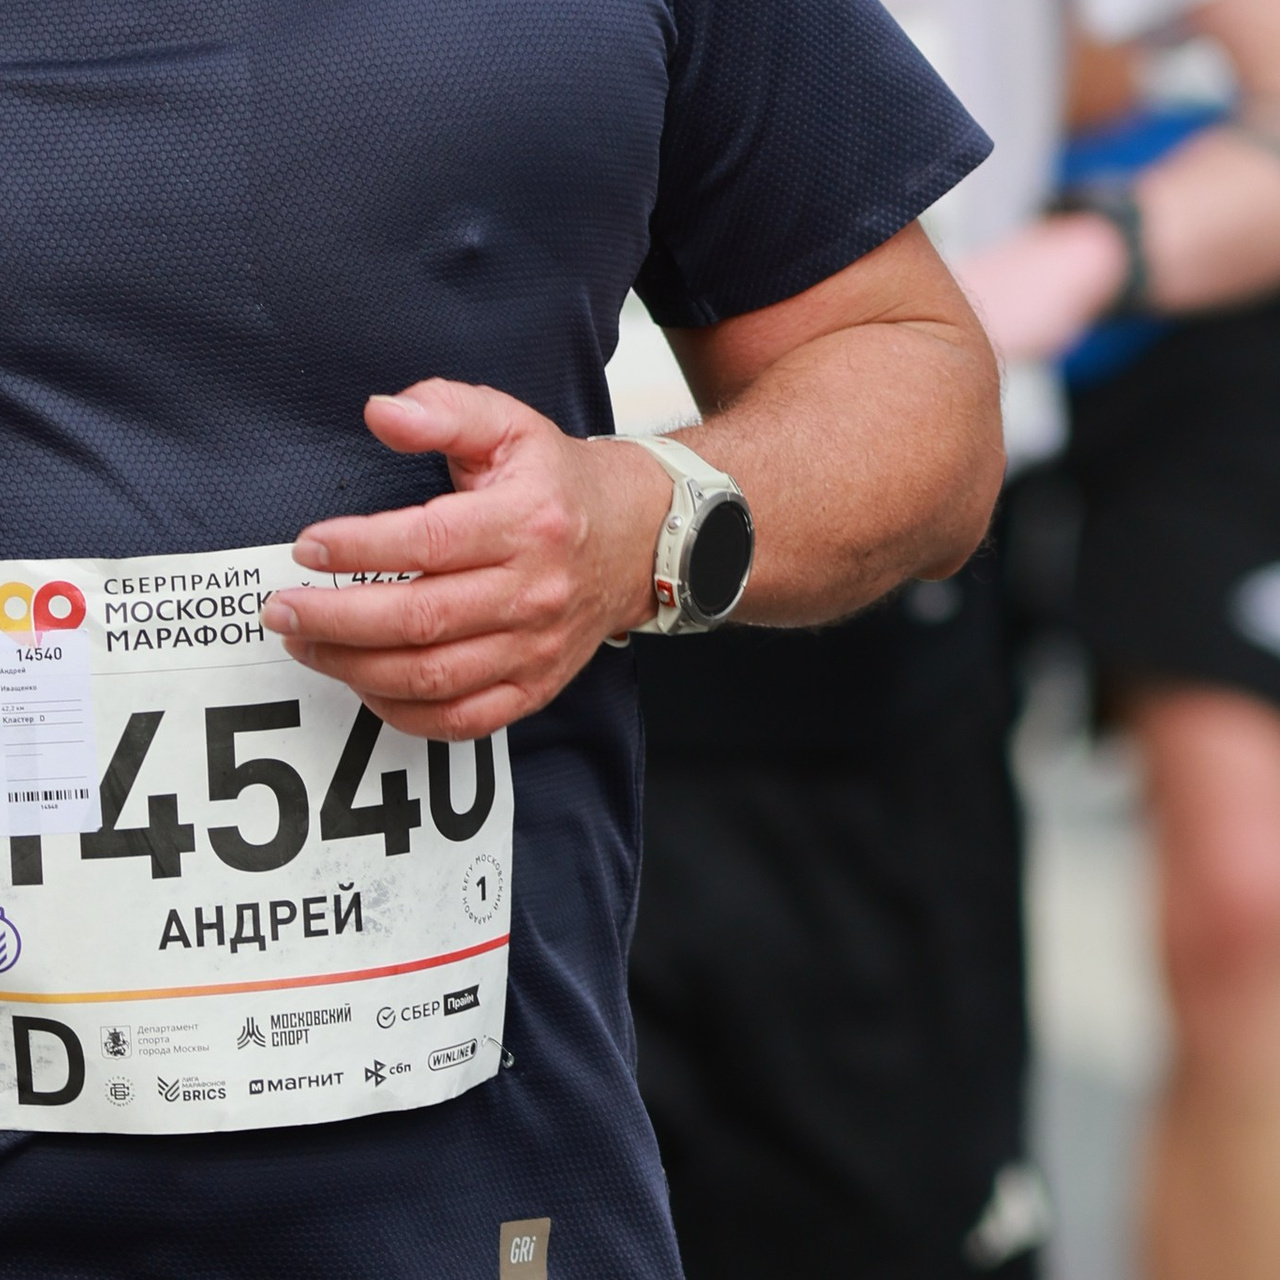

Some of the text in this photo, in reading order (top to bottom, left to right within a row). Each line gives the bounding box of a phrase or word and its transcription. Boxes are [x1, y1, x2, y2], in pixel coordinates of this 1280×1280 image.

[104, 566, 261, 595] СБЕРПРАЙМ
[105, 590, 276, 624] МОСКОВСК
[106, 621, 265, 652] МАРАФОН
[15, 646, 63, 662] 14540
[2, 716, 34, 724] Кластер
[476, 875, 487, 901] 1
[158, 882, 364, 954] АНДРЕЙ
[270, 1003, 352, 1030] МОСКОВСКИЙ
[401, 993, 475, 1021] СБЕР Прайм
[137, 1023, 200, 1035] Департамент
[271, 1028, 310, 1047] СПОРТ
[138, 1036, 170, 1045] спорта
[138, 1044, 210, 1056] города Москвы
[12, 1015, 85, 1106] D
[432, 1048, 470, 1067] WINLINE
[389, 1062, 412, 1075] сбп
[267, 1072, 344, 1092] магнит
[182, 1088, 227, 1102] BRICS
